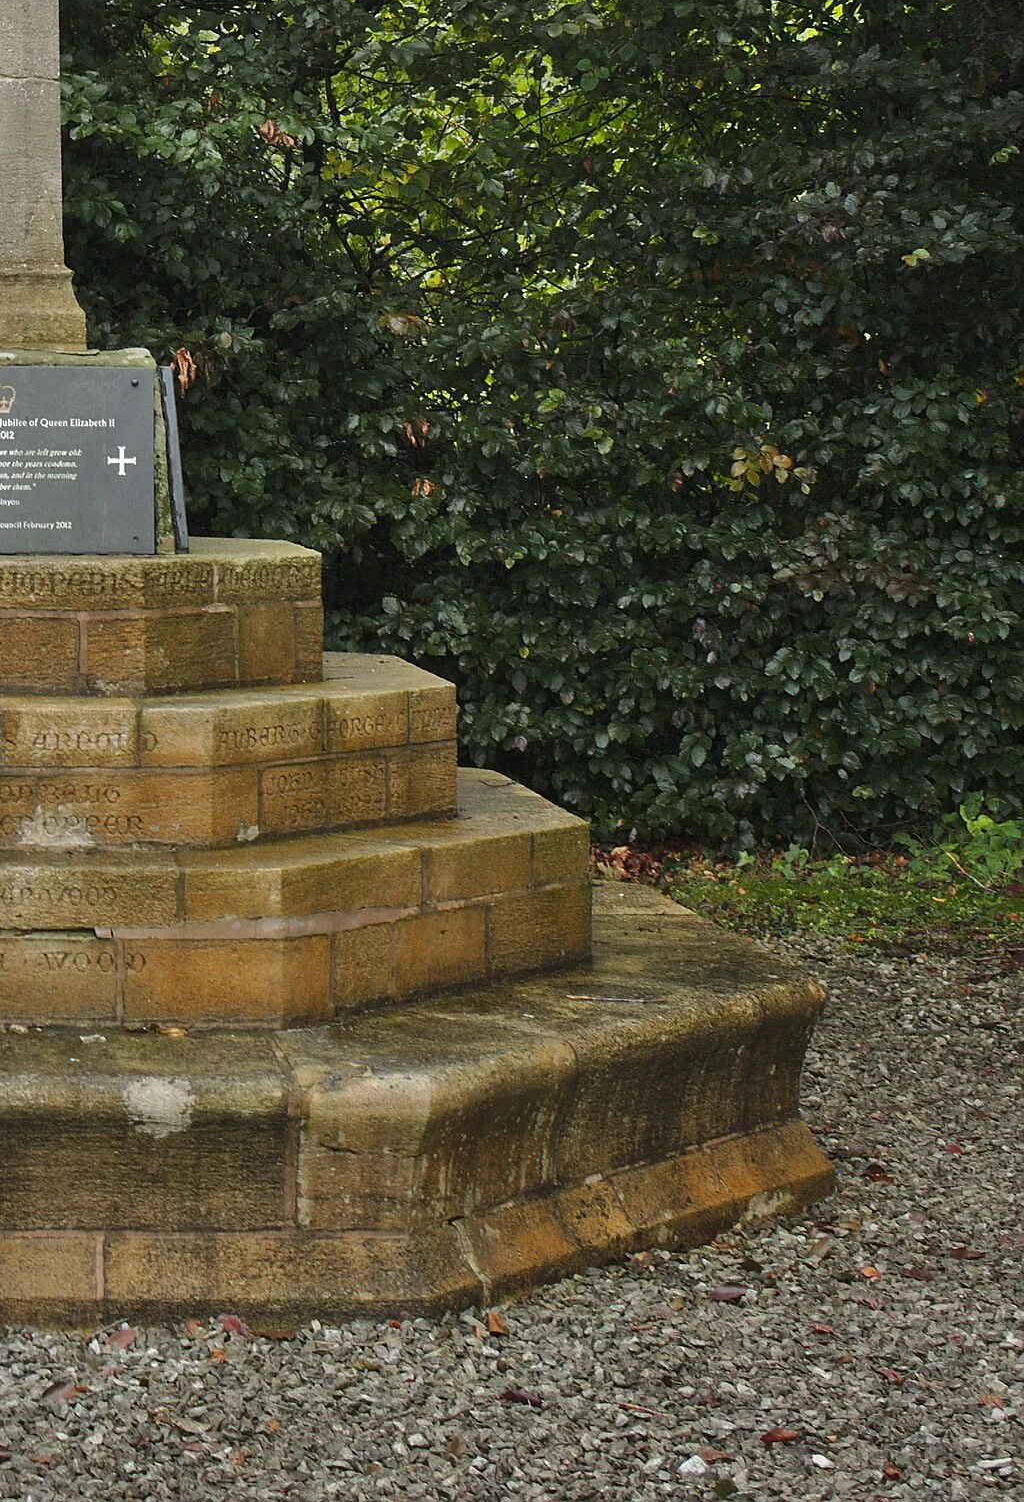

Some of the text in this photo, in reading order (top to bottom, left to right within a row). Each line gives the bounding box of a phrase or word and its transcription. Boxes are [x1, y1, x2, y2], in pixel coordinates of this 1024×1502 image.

[29, 417, 38, 428] of
[40, 417, 67, 428] Queen
[70, 417, 107, 428] Elizabeth
[109, 417, 115, 428] II
[9, 447, 23, 457] who
[25, 447, 36, 457] are
[37, 447, 49, 457] left
[49, 447, 67, 457] grow
[12, 459, 23, 468] the
[24, 459, 43, 468] years
[11, 471, 25, 480] and
[26, 471, 33, 480] in
[34, 471, 46, 480] the
[47, 471, 78, 480] morning
[23, 520, 54, 529] February
[56, 520, 73, 529] 2012
[42, 950, 148, 973] WOOD
